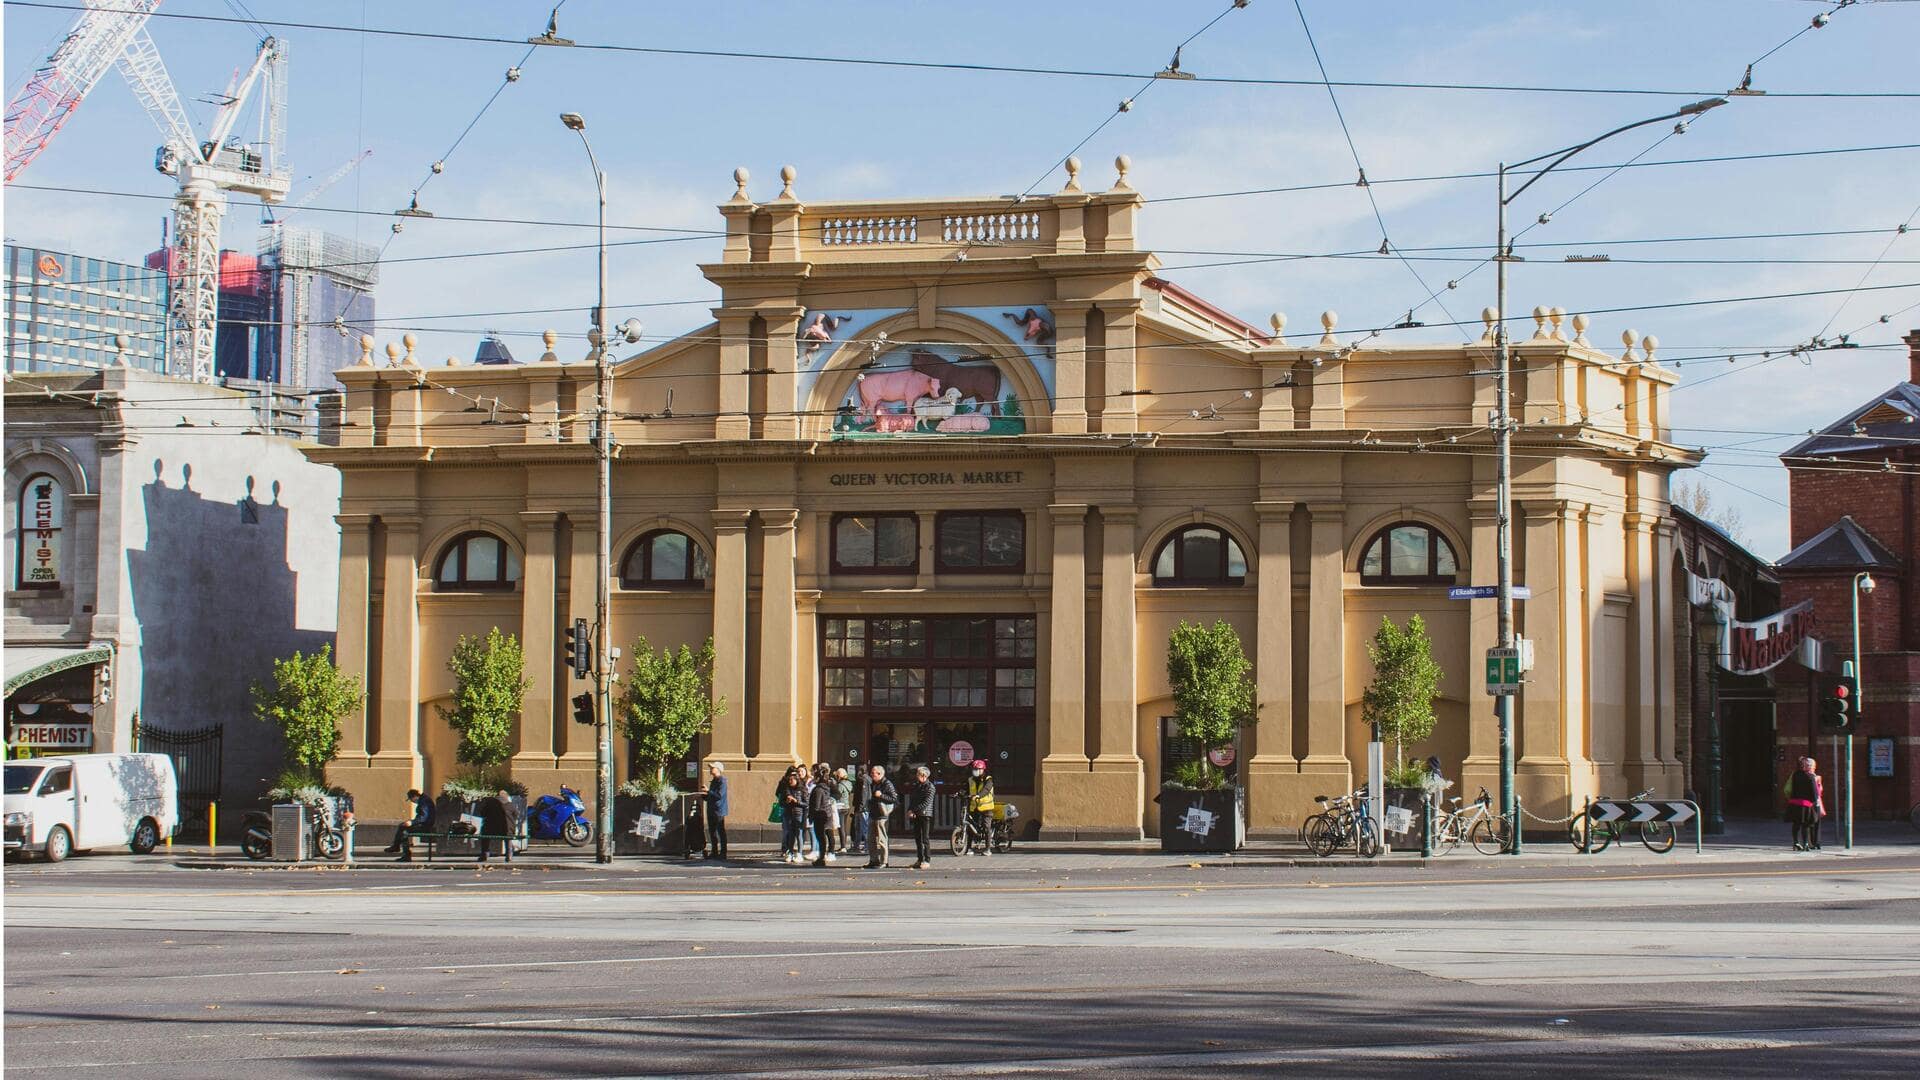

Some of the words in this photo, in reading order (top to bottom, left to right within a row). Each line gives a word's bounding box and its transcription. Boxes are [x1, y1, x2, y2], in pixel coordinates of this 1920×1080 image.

[830, 473, 876, 486] QUEEN
[884, 472, 955, 486] VICTORIA
[962, 471, 1024, 485] MARKET
[35, 501, 52, 567] CHEMIST
[1455, 587, 1485, 596] Elizabeth
[1486, 587, 1494, 595] St
[1488, 649, 1517, 657] FAIRWAY
[17, 727, 87, 744] CHEMIST
